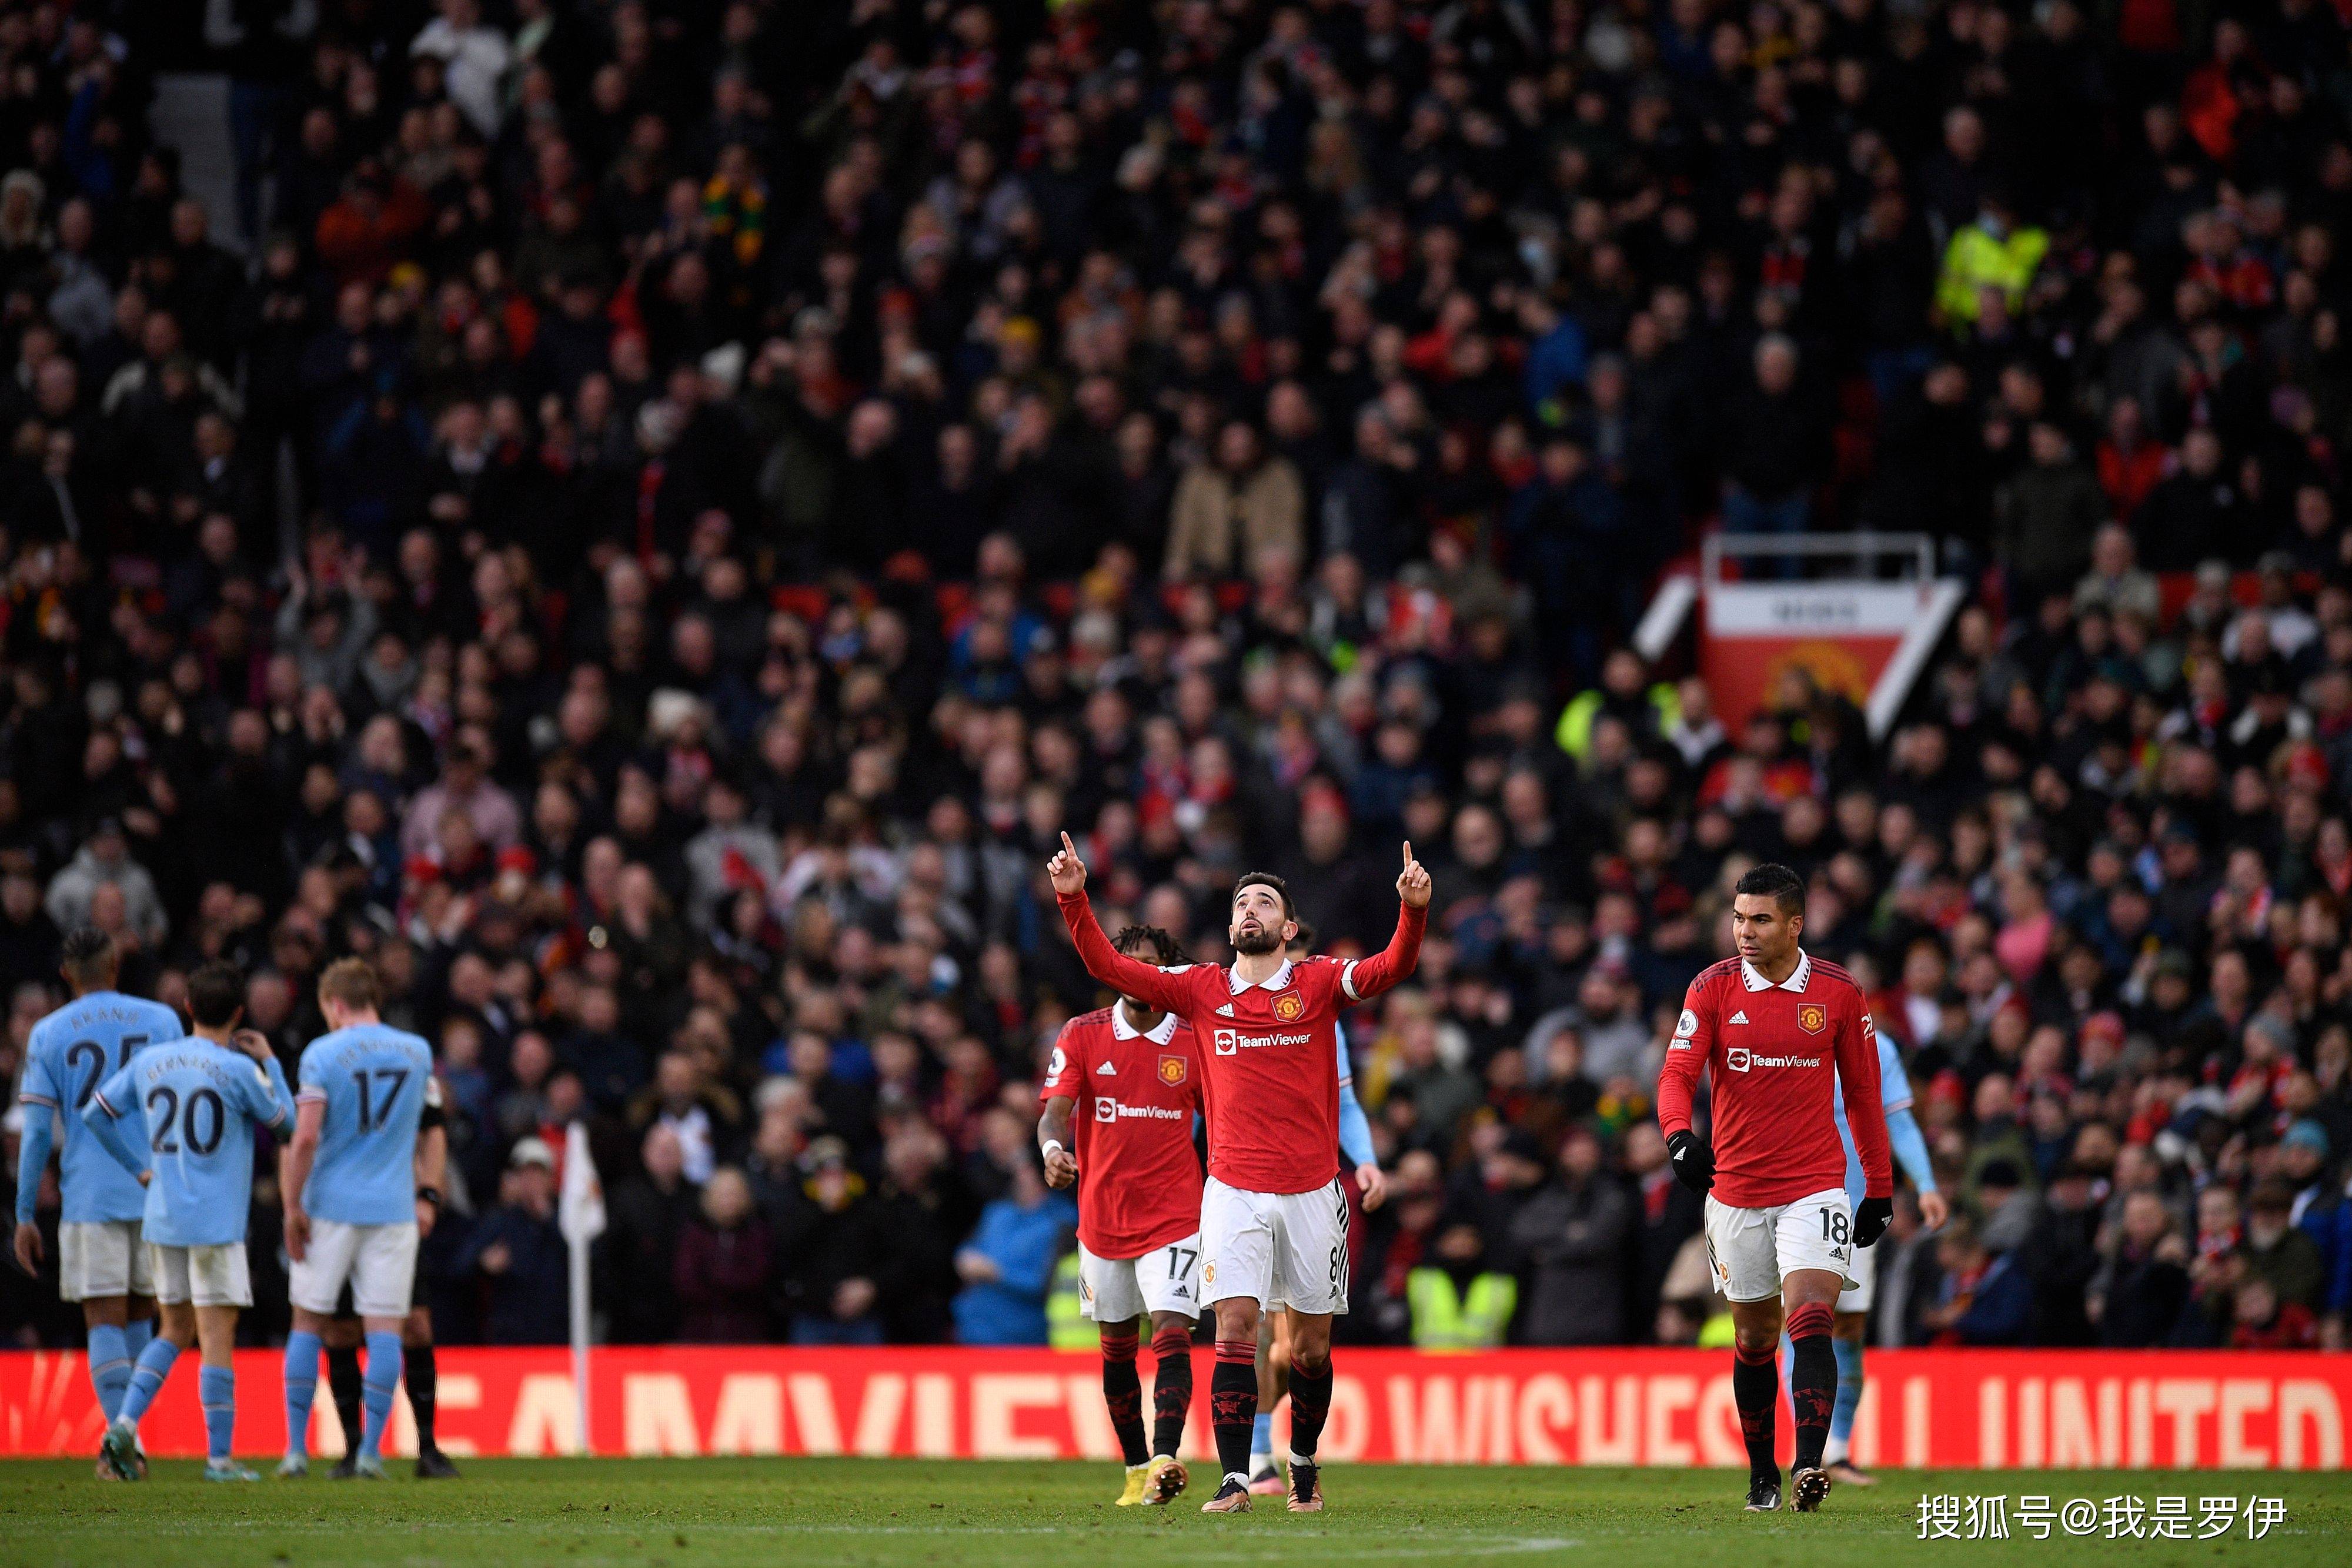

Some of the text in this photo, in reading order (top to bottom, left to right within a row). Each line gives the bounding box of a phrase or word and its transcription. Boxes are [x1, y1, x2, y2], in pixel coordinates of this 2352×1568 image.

[1237, 1034, 1311, 1048] TeamViewer
[1751, 1054, 1821, 1068] TeamViewer
[353, 1068, 409, 1134] 17
[1116, 1104, 1182, 1119] TeamViewer
[148, 1087, 225, 1156] 20
[1819, 1207, 1849, 1246] 18
[1168, 1247, 1198, 1281] 17
[1329, 1246, 1338, 1283] 8
